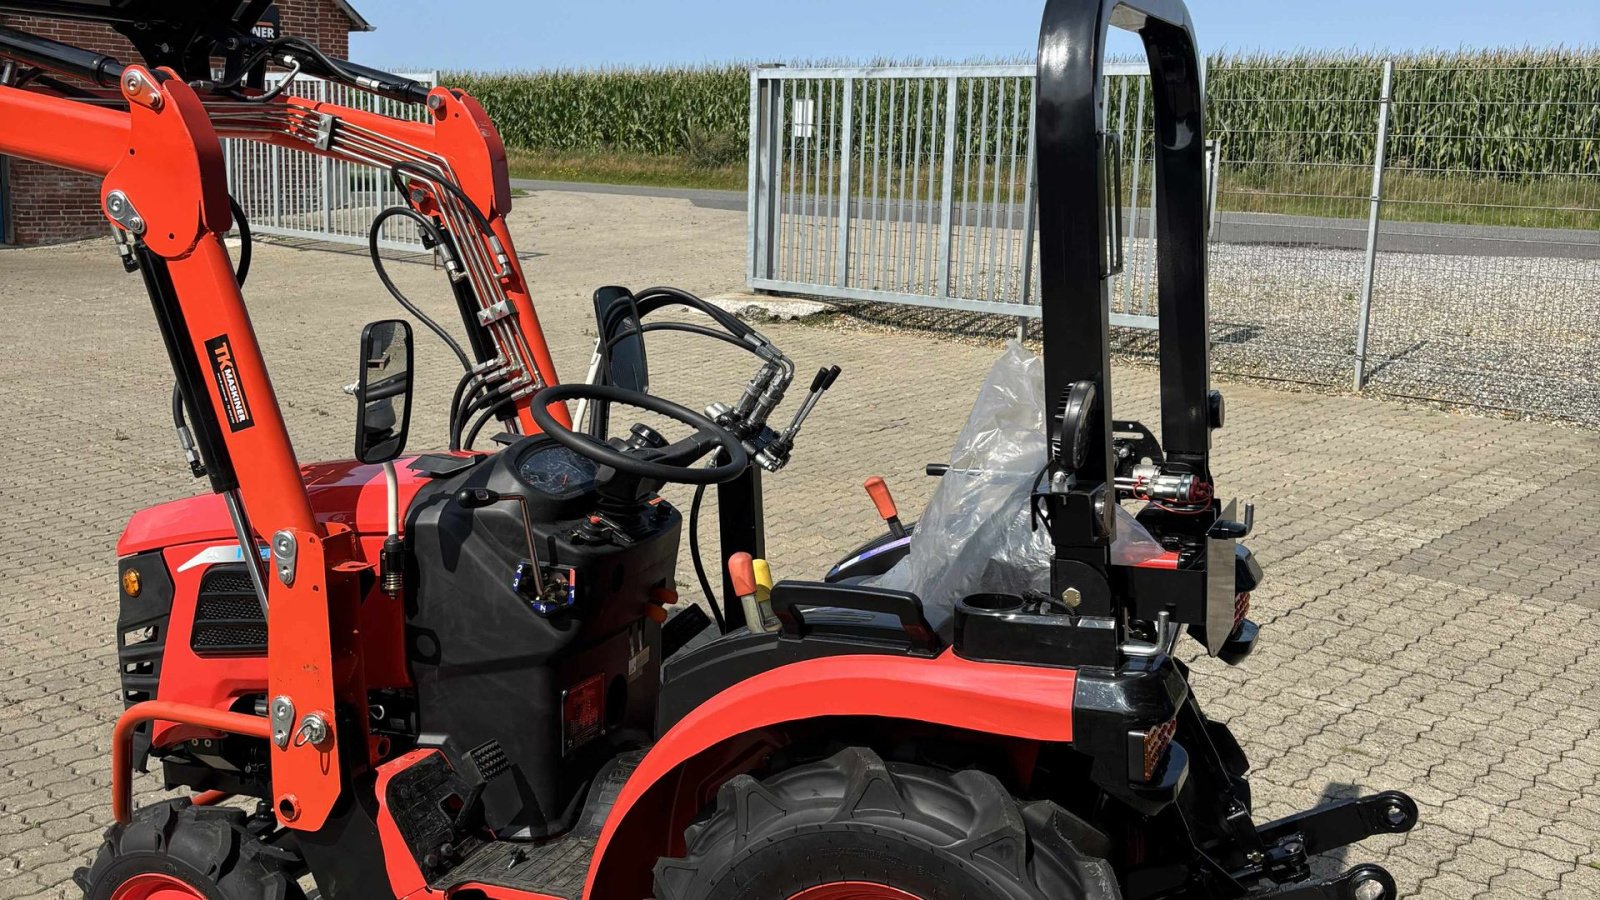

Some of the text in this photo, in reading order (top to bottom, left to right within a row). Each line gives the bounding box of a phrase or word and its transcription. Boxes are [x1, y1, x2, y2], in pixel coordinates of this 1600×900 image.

[214, 342, 233, 371] TK
[224, 368, 246, 422] MASKINER
[516, 564, 523, 573] 2
[512, 578, 519, 587] 3
[569, 589, 575, 598] 1
